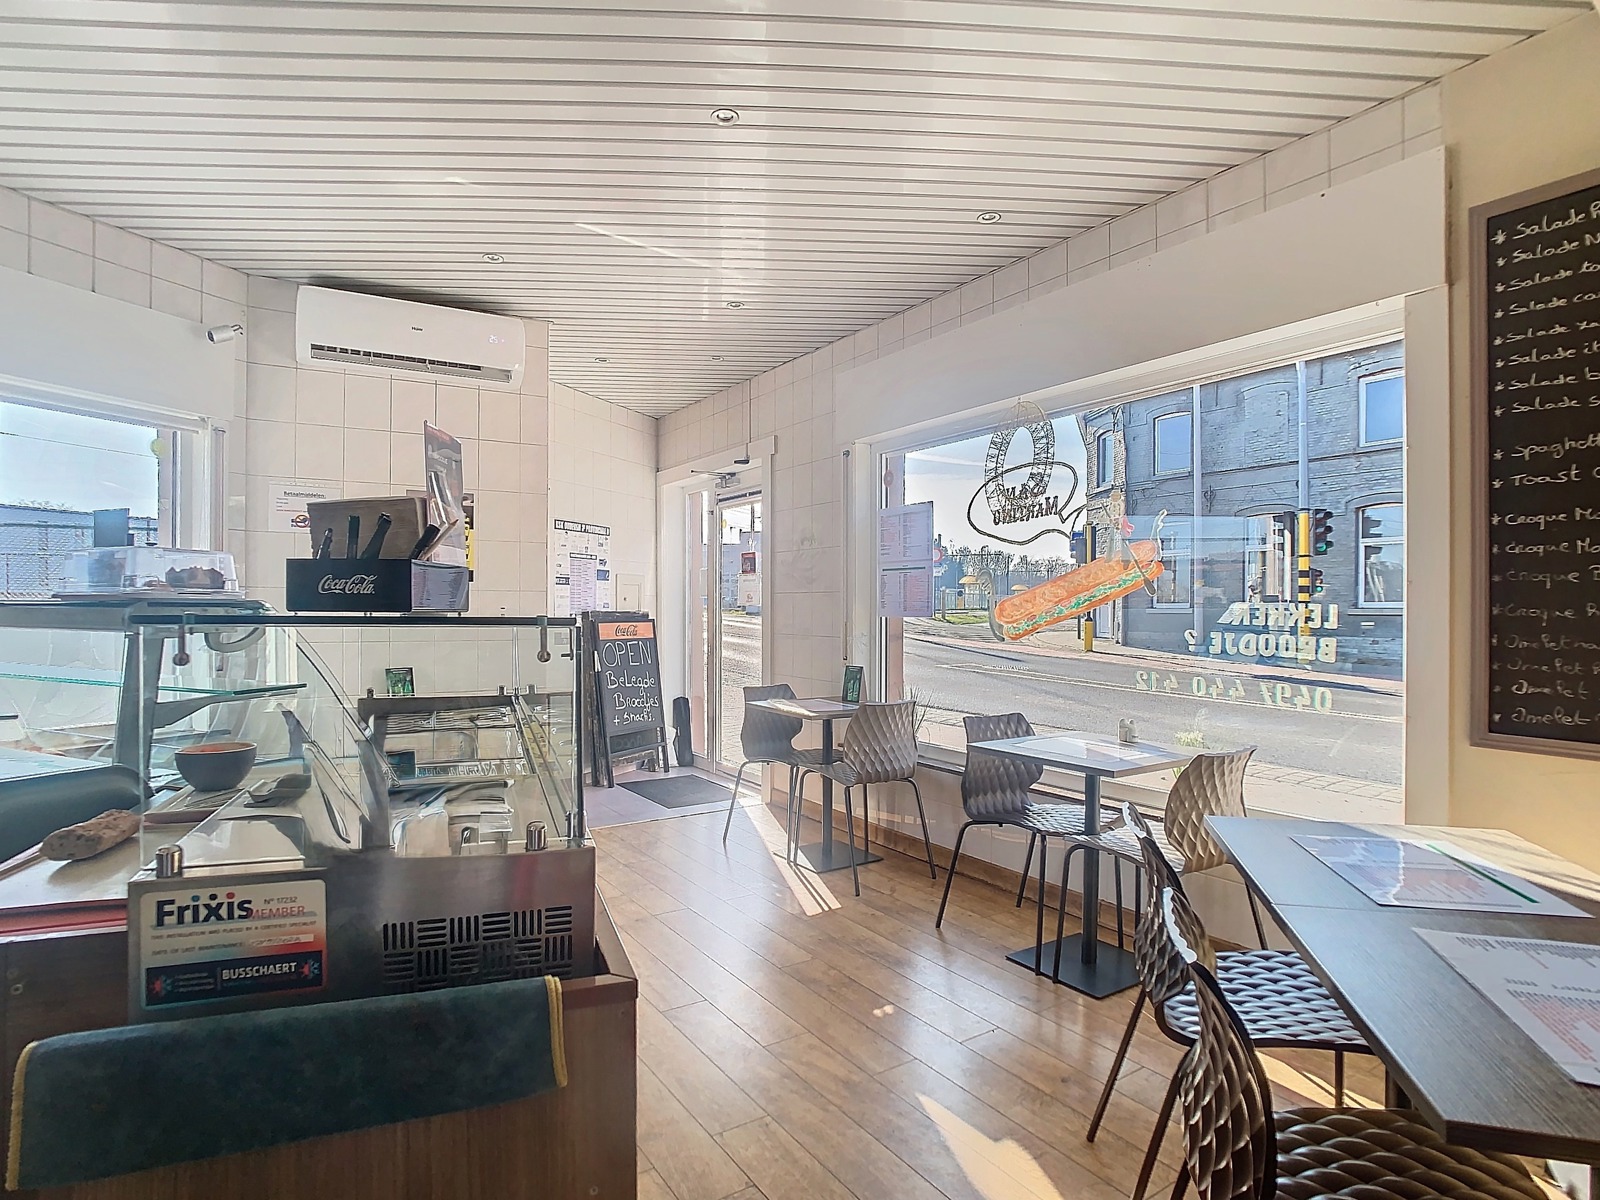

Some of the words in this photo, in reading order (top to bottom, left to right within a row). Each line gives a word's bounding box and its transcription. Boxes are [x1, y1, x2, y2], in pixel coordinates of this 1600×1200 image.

[1511, 208, 1586, 240] Salade
[1511, 240, 1580, 264] Salade
[1506, 269, 1574, 292] Salade
[1508, 296, 1568, 315] Salade
[1505, 324, 1572, 343] Salade
[1507, 346, 1577, 366] Salade
[1507, 372, 1579, 390] Salade
[1511, 395, 1582, 413] Salade
[1509, 463, 1582, 487] Toast
[1504, 513, 1568, 531] Croque
[1504, 540, 1571, 557] Croque
[1506, 568, 1580, 590] Croque
[1504, 602, 1577, 627] Croque
[602, 640, 653, 668] OPEN
[155, 892, 254, 928] Frixis
[250, 905, 306, 919] MEMBER
[221, 961, 298, 981] BUSSCHAERT
